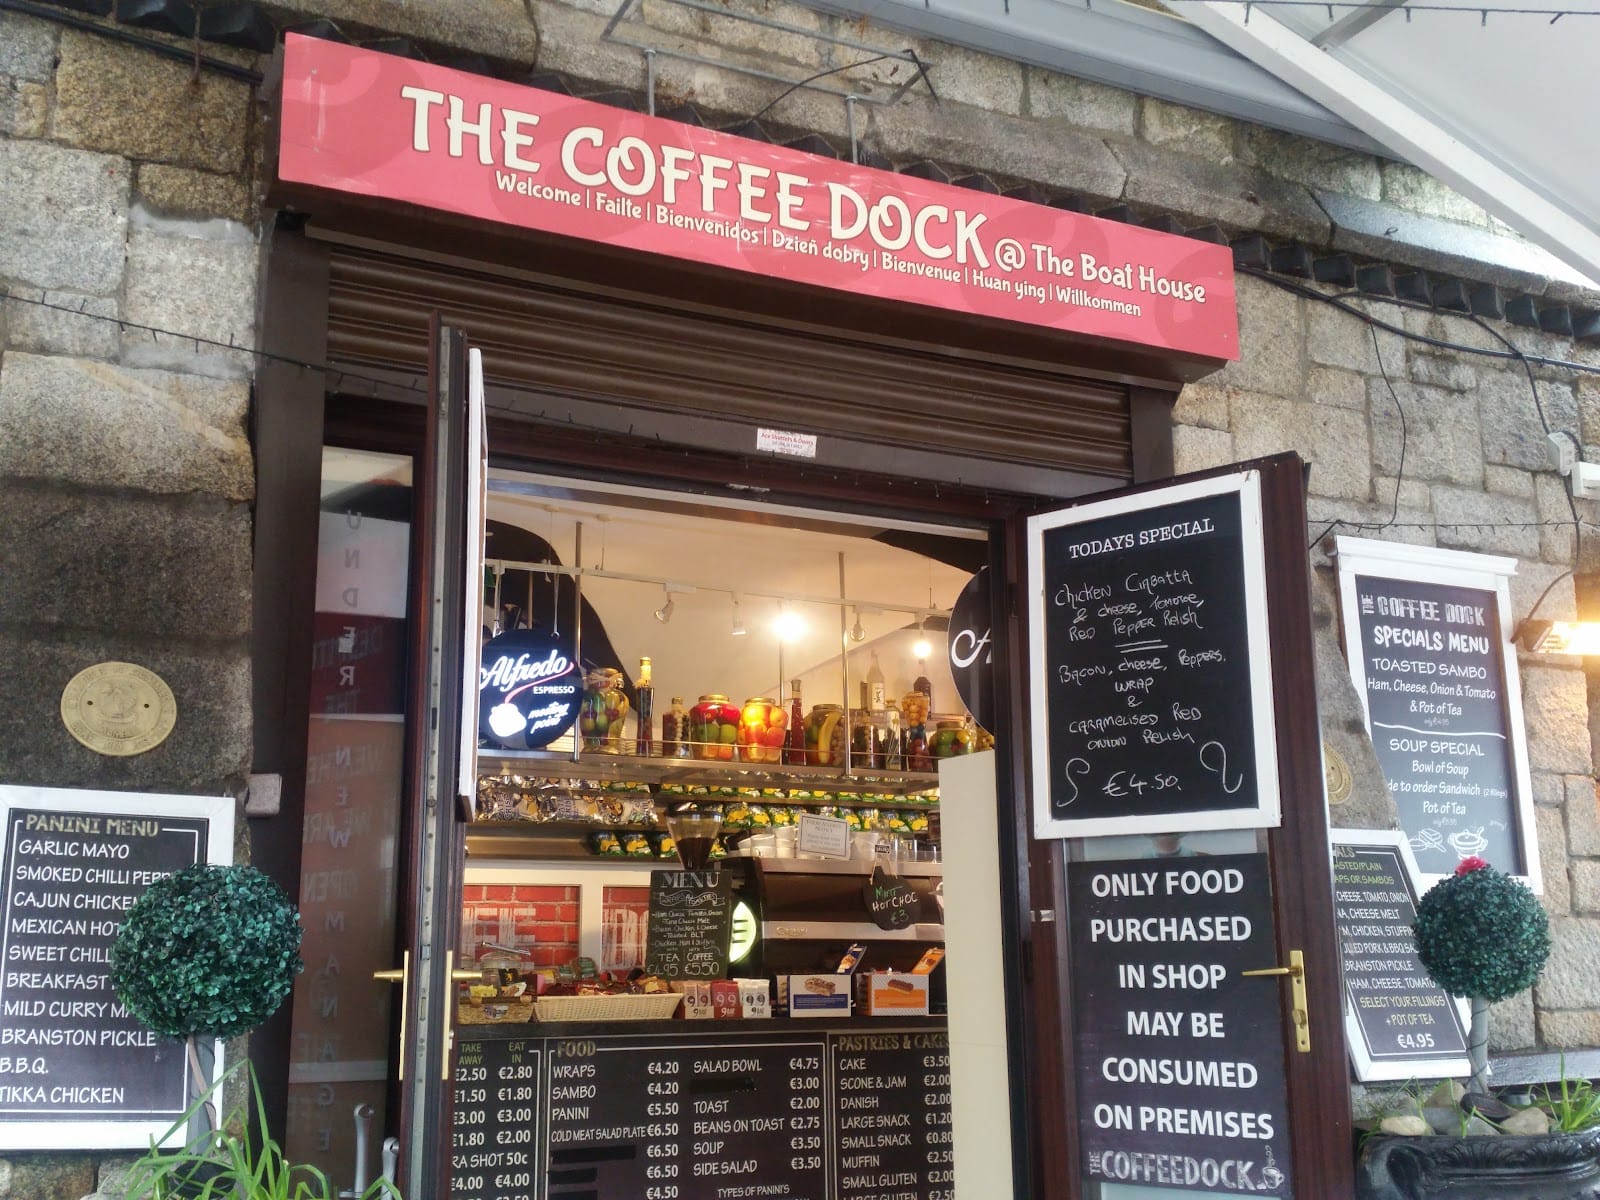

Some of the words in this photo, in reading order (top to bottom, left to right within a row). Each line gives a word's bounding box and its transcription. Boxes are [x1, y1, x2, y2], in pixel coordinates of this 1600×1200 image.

[401, 85, 541, 174] THE
[560, 126, 810, 232] COFFEE
[827, 181, 990, 270] DOCK
[994, 238, 1026, 272] @
[1031, 243, 1074, 278] The
[1081, 254, 1133, 291] Boat
[1138, 267, 1206, 304] House
[495, 170, 582, 207] Welcome
[596, 192, 642, 220] Failte
[655, 204, 760, 245] Bienvenidos
[822, 241, 869, 272] dobry
[882, 253, 961, 285] Bienvenue
[972, 269, 1011, 293] Huan
[1015, 279, 1045, 304] ying
[1056, 285, 1142, 317] Willkommen
[1069, 533, 1135, 559] TODAYS
[1139, 518, 1215, 546] SPECIAL
[1072, 608, 1088, 624] &
[1377, 596, 1440, 621] COFFEE
[1445, 603, 1485, 626] DOCK
[1374, 625, 1443, 651] SPECIALS
[1449, 632, 1489, 654] MENU
[480, 649, 567, 692] Alfredo
[1372, 658, 1436, 674] TOASTED
[1439, 664, 1486, 679] SAMBO
[533, 686, 574, 694] ESPRESSO
[1368, 678, 1391, 692] Ham,
[1394, 679, 1429, 695] Cheese,
[1431, 682, 1454, 696] Onion
[1456, 685, 1463, 696] &
[1464, 685, 1496, 699] Tomato
[1127, 695, 1144, 708] &
[1410, 701, 1417, 712] &
[1419, 701, 1434, 714] Pot
[1436, 702, 1445, 714] of
[1447, 703, 1462, 716] Tea
[1390, 739, 1428, 753] SOUP
[1431, 741, 1485, 756] SPECIAL
[1412, 760, 1433, 773] Bowl
[1436, 761, 1446, 773] of
[1447, 763, 1469, 779] Soup
[1400, 781, 1411, 792] to
[1413, 781, 1437, 793] order
[1439, 782, 1480, 796] Sandwich
[1423, 801, 1439, 814] Pot
[1441, 802, 1450, 814] of
[1452, 802, 1466, 815] Tea
[25, 814, 100, 834] PANINI
[106, 818, 159, 837] MENU
[18, 839, 79, 857] GARLIC
[82, 843, 130, 859] MAYO
[16, 865, 82, 883] SMOKED
[85, 868, 129, 885] CHILLI
[662, 872, 720, 888] MENU
[1091, 871, 1158, 897] ONLY
[1166, 869, 1244, 895] FOOD
[13, 891, 70, 909] CAJUN
[11, 918, 86, 936] MEXICAN
[90, 921, 120, 937] HOT
[1091, 916, 1252, 942] PURCHASED
[8, 945, 68, 962] SWEET
[69, 947, 112, 963] CHILL
[6, 972, 109, 990] BREAKFAST
[1119, 964, 1145, 989] IN
[1153, 964, 1227, 989] SHOP
[4, 1000, 46, 1017] MILD
[49, 1001, 108, 1018] CURRY
[1360, 996, 1390, 1008] SELECT
[1413, 995, 1445, 1007] FILLINGS
[1127, 1011, 1184, 1036] MAY
[1191, 1013, 1225, 1038] BE
[1, 1028, 96, 1046] BRANSTON
[100, 1030, 157, 1048] PICKLE
[840, 1035, 899, 1051] PASTRIES
[903, 1035, 911, 1049] &
[1397, 1033, 1435, 1049] €4.95
[462, 1043, 481, 1053] TAKE
[509, 1042, 526, 1052] EAT
[557, 1040, 596, 1057] FOOD
[0, 1057, 49, 1075] B.B.Q.
[459, 1055, 482, 1066] AWAY
[512, 1054, 521, 1063] IN
[694, 1060, 730, 1073] SALAD
[732, 1059, 762, 1072] BOWL
[789, 1058, 819, 1070] €4.75
[840, 1058, 867, 1070] CAKE
[499, 1066, 532, 1079] €2.80
[553, 1065, 595, 1078] WRAPS
[648, 1062, 679, 1075] €4.20
[1102, 1057, 1258, 1089] CONSUMED
[552, 1085, 596, 1099] SAMBO
[648, 1082, 679, 1095] €4.20
[840, 1077, 874, 1090] SCONE
[875, 1077, 884, 1088] &
[885, 1076, 907, 1088] JAM
[0, 1086, 46, 1103] TIKKA
[51, 1087, 125, 1104] CHICKEN
[498, 1087, 532, 1101] €1.80
[841, 1096, 879, 1109] DANISH
[552, 1107, 589, 1120] PANINI
[647, 1103, 679, 1116] €5.50
[694, 1100, 728, 1114] TOAST
[790, 1097, 819, 1109] €2.00
[497, 1109, 531, 1122] €3.00
[841, 1116, 876, 1129] LARGE
[877, 1114, 911, 1127] SNACK
[1094, 1104, 1133, 1130] ON
[1141, 1107, 1274, 1140] PREMISES
[552, 1130, 572, 1142] COLD
[573, 1128, 595, 1141] MEAT
[596, 1127, 621, 1140] SALAD
[623, 1126, 646, 1138] PLATE
[647, 1123, 679, 1136] €6.50
[694, 1120, 731, 1134] BEANS
[733, 1119, 748, 1133] ON
[750, 1118, 784, 1131] TOAST
[790, 1117, 820, 1130] €2.75
[497, 1130, 531, 1144] €2.00
[841, 1136, 876, 1149] SMALL
[878, 1134, 912, 1147] SNACK
[694, 1141, 724, 1156] SOUP
[790, 1137, 820, 1150] €3.50
[470, 1153, 504, 1168] SHOT
[506, 1152, 528, 1166] 50c
[694, 1162, 719, 1176] SIDE
[721, 1160, 757, 1174] SALAD
[791, 1157, 820, 1169] €3.50
[842, 1155, 880, 1169] MUFFIN
[496, 1173, 529, 1187] €4.00
